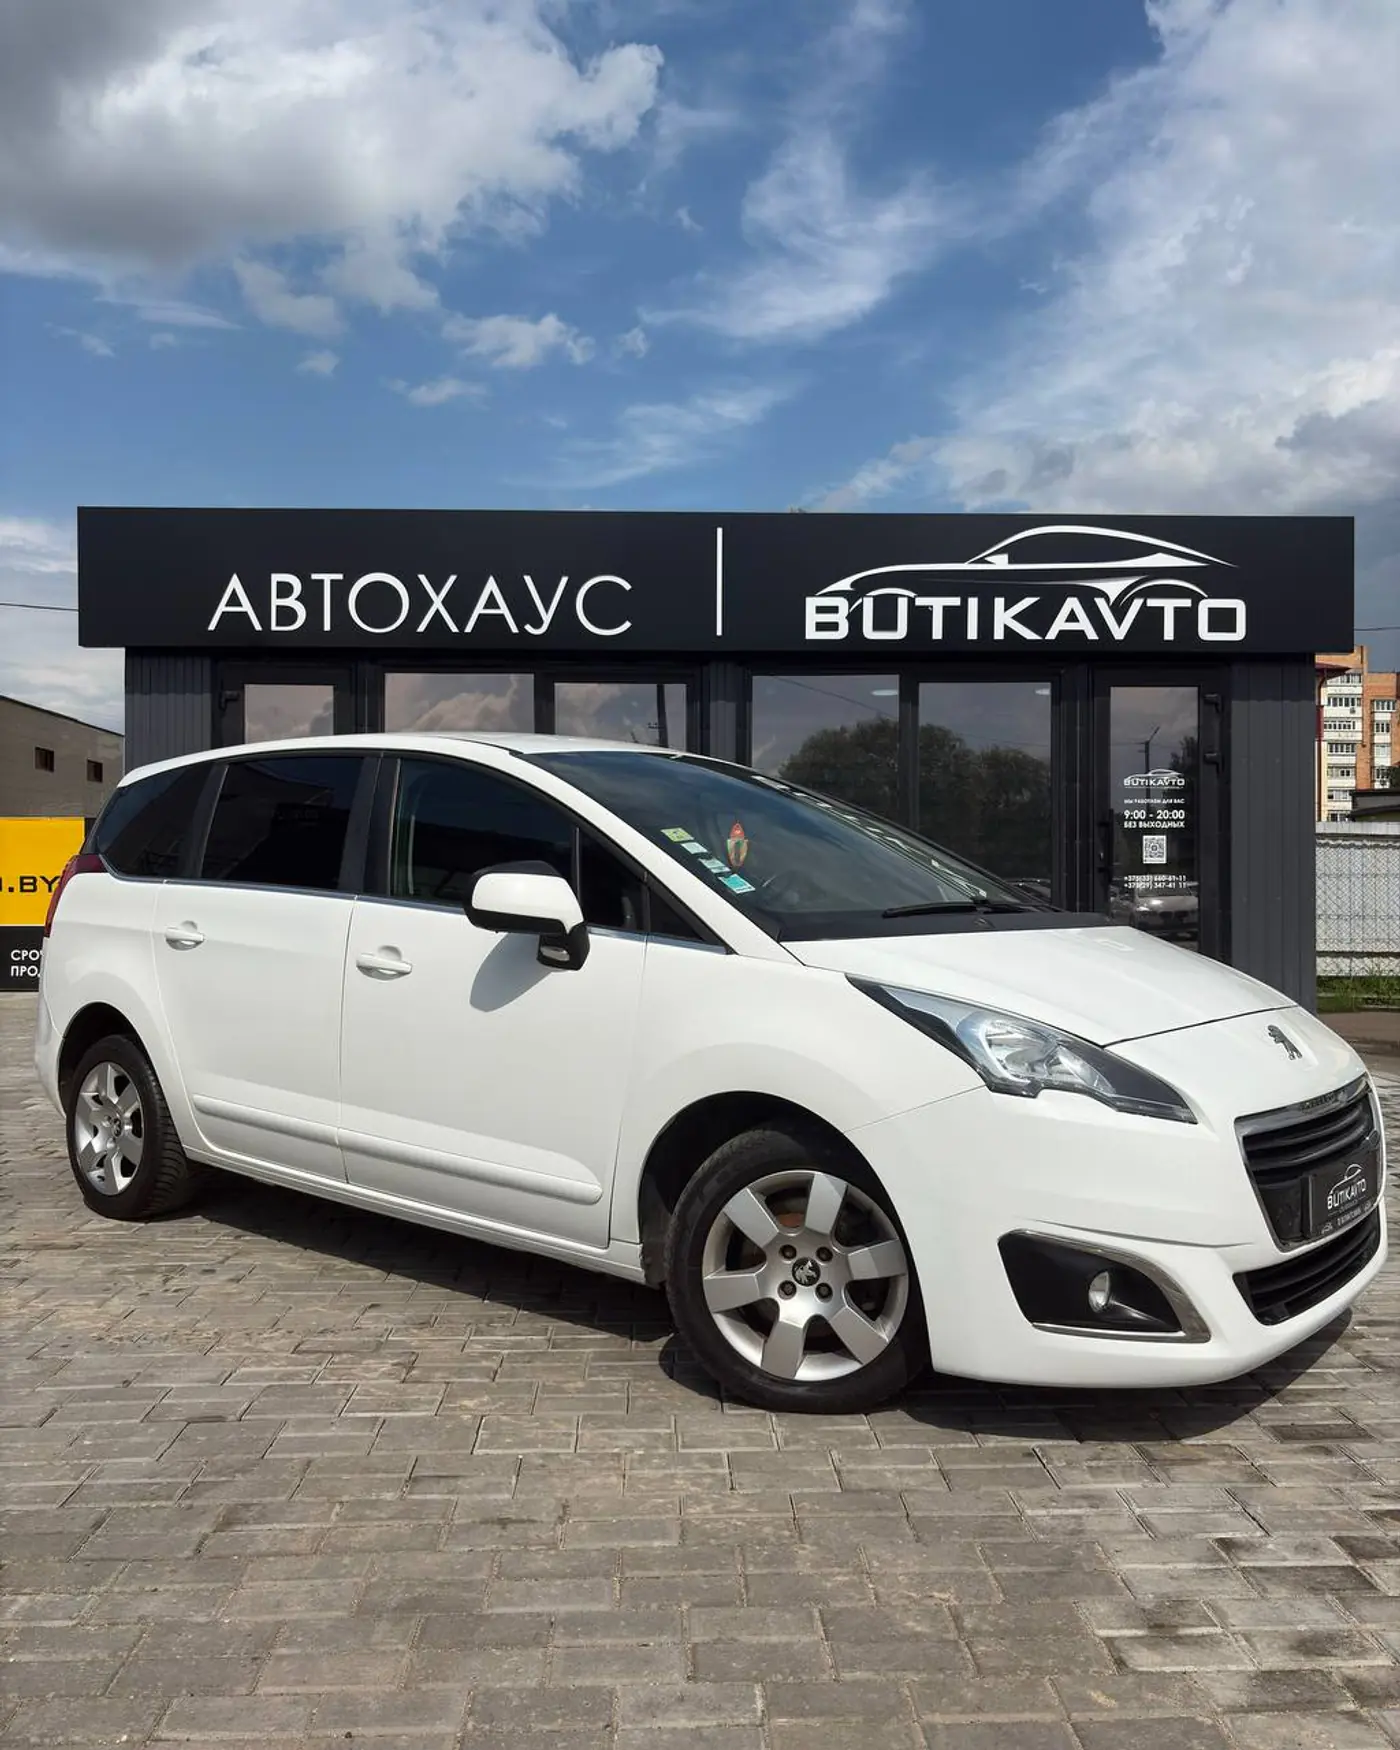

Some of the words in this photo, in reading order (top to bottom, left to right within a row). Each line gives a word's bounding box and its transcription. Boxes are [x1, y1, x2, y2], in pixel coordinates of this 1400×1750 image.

[207, 571, 632, 636] АВТОХАУС
[804, 596, 1247, 643] BUTIKAVTO
[1124, 778, 1185, 786] BUTIKAVTO
[1124, 810, 1146, 819] 9:00
[1156, 810, 1185, 819] 20:00
[1138, 821, 1185, 829] ВЫХОДНЫХ
[0, 876, 60, 892] .BY
[11, 966, 41, 977] ПРО
